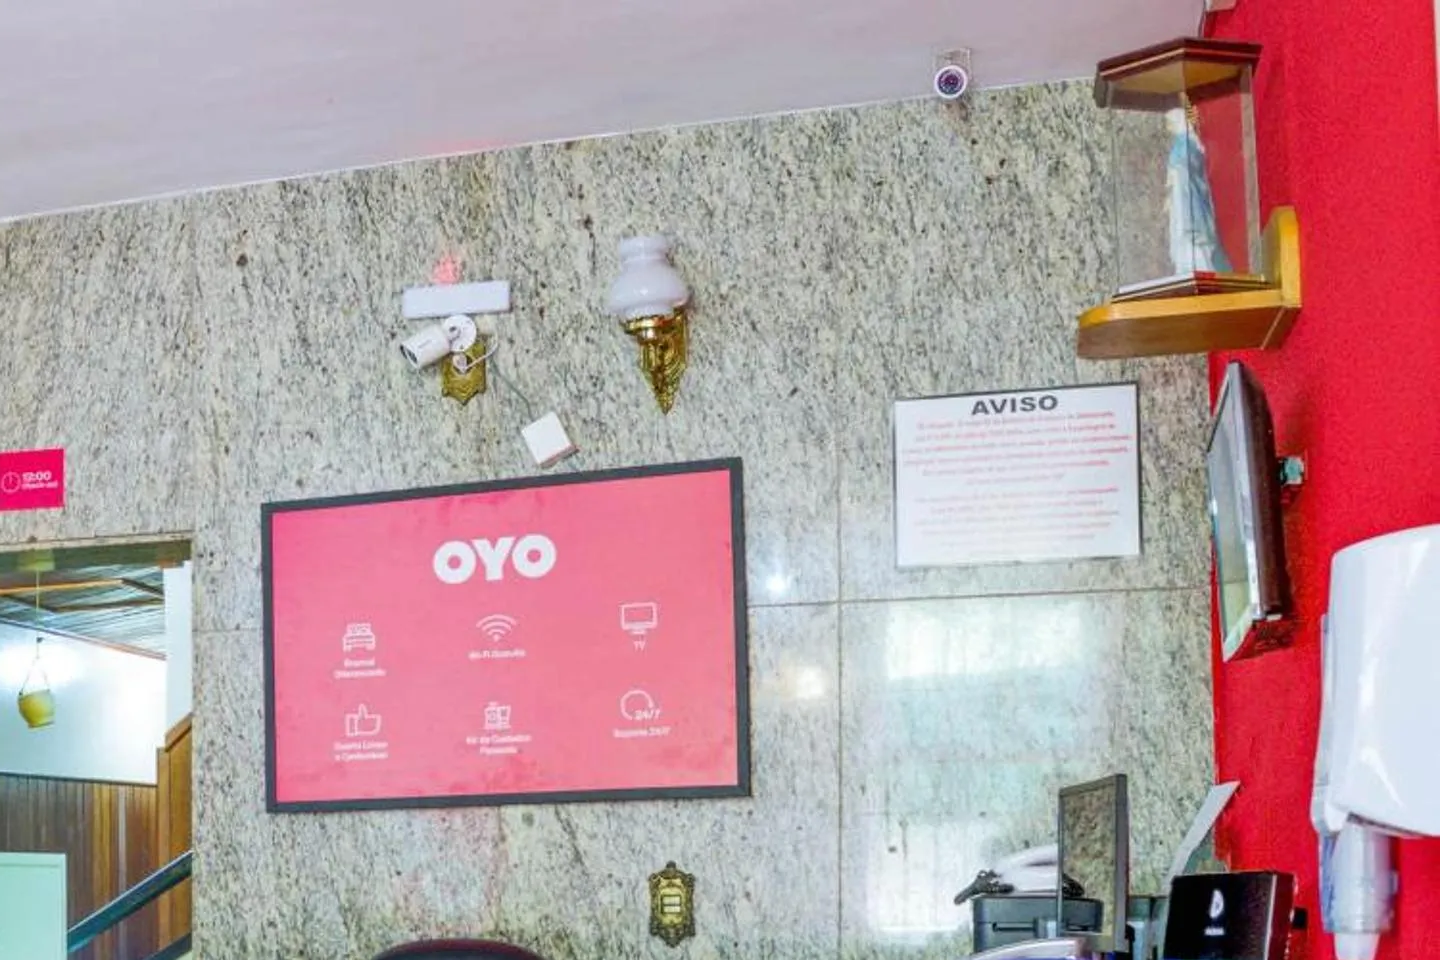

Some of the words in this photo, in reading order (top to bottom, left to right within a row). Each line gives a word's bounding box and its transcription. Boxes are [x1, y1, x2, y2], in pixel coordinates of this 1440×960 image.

[971, 395, 1058, 415] AVISO
[433, 534, 557, 584] OYO
[633, 640, 646, 652] TV
